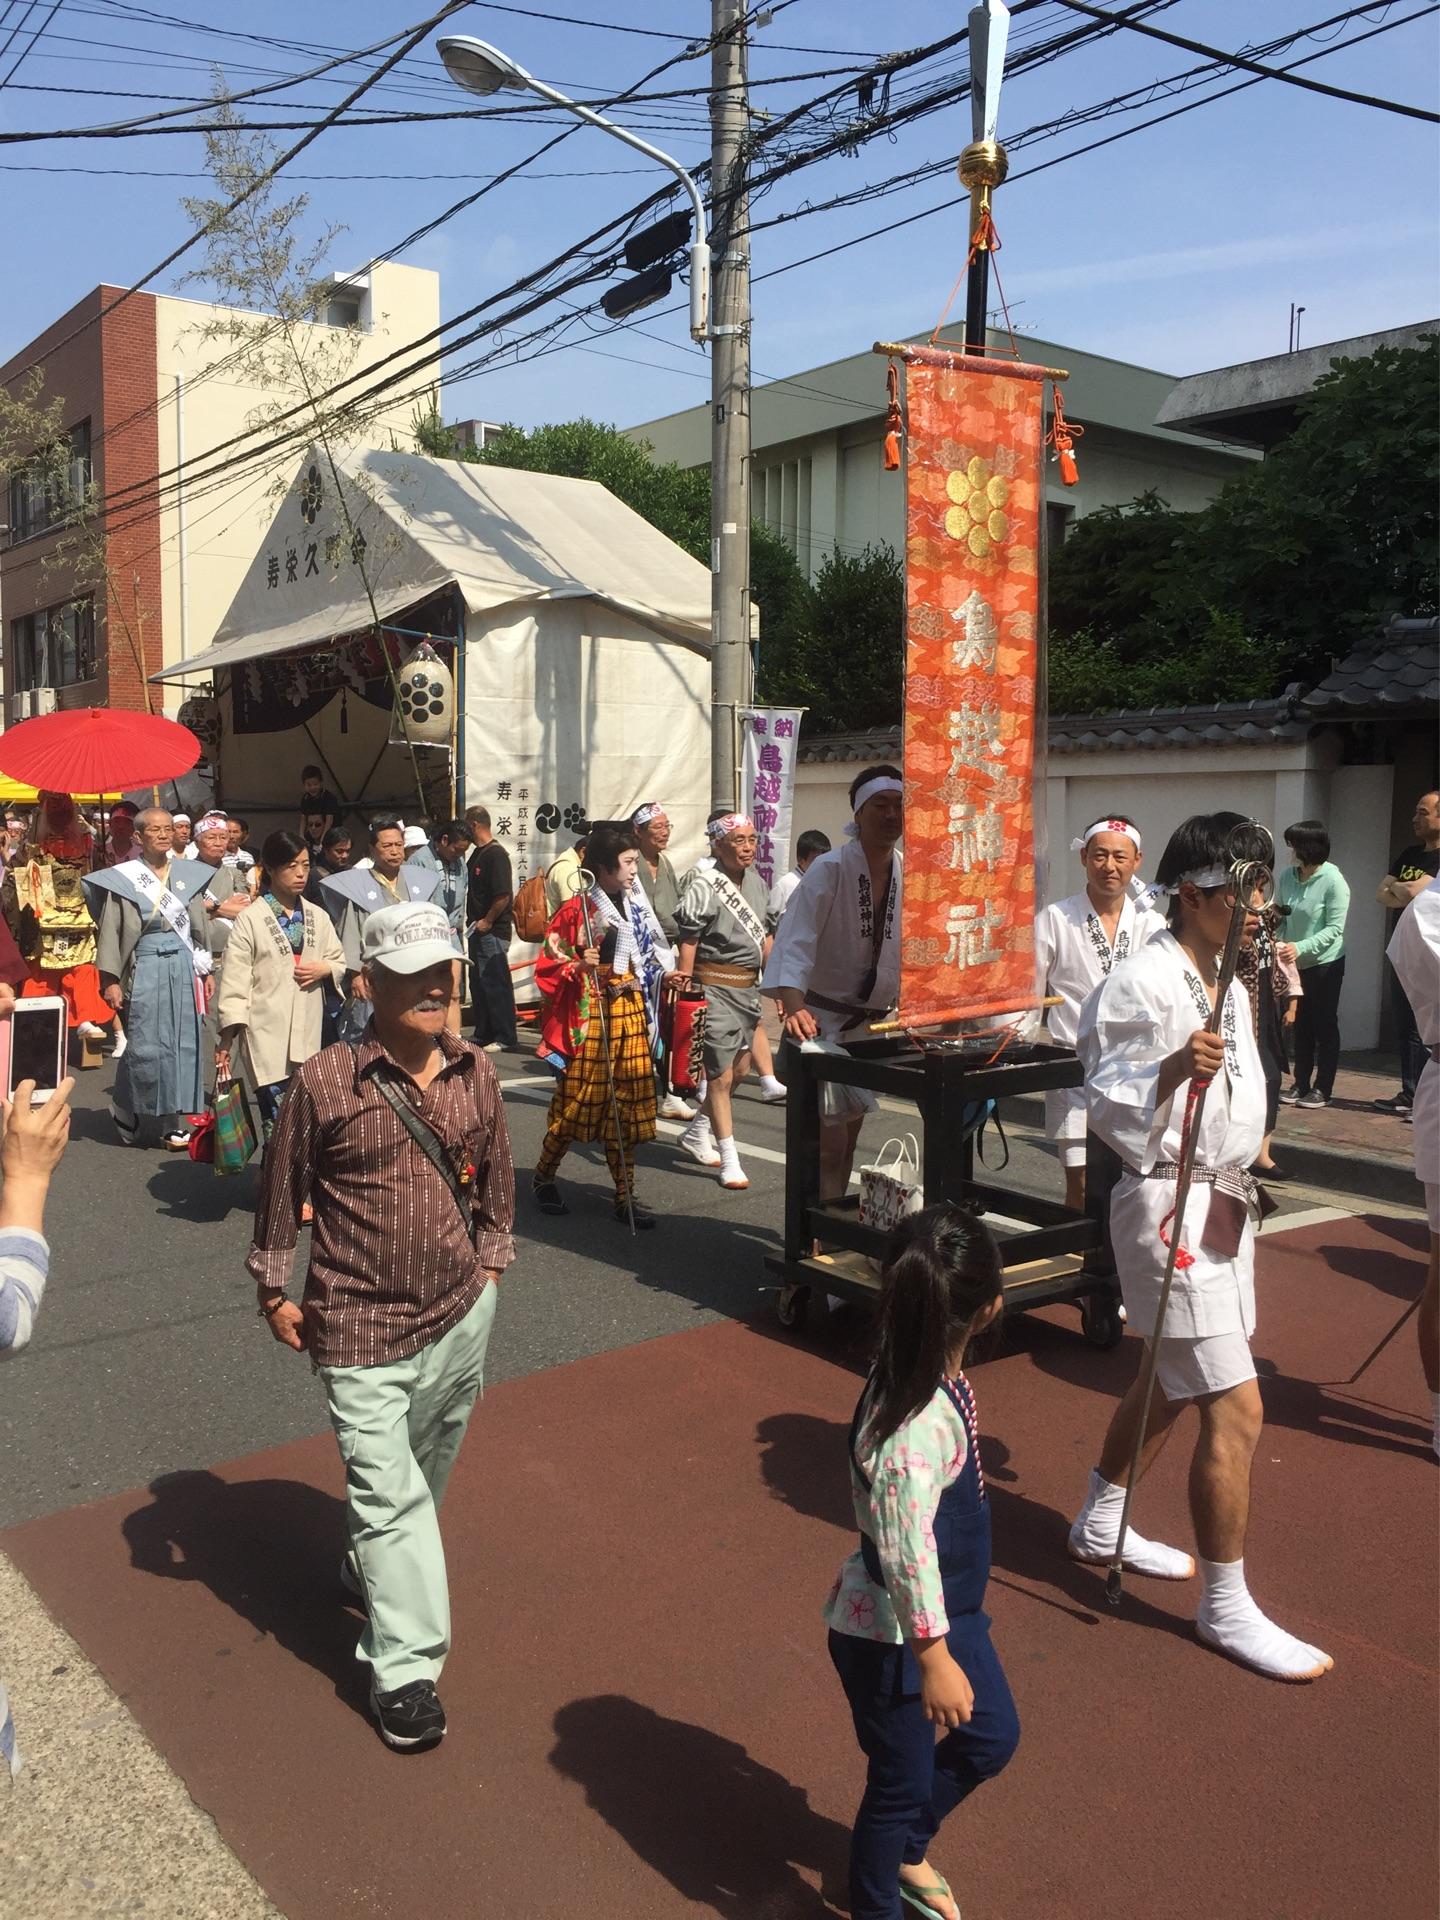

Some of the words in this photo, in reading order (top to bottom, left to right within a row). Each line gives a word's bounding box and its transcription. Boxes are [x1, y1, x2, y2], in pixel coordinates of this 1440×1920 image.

[496, 781, 513, 836] 寿栄
[943, 590, 1008, 971] 鳥越神社
